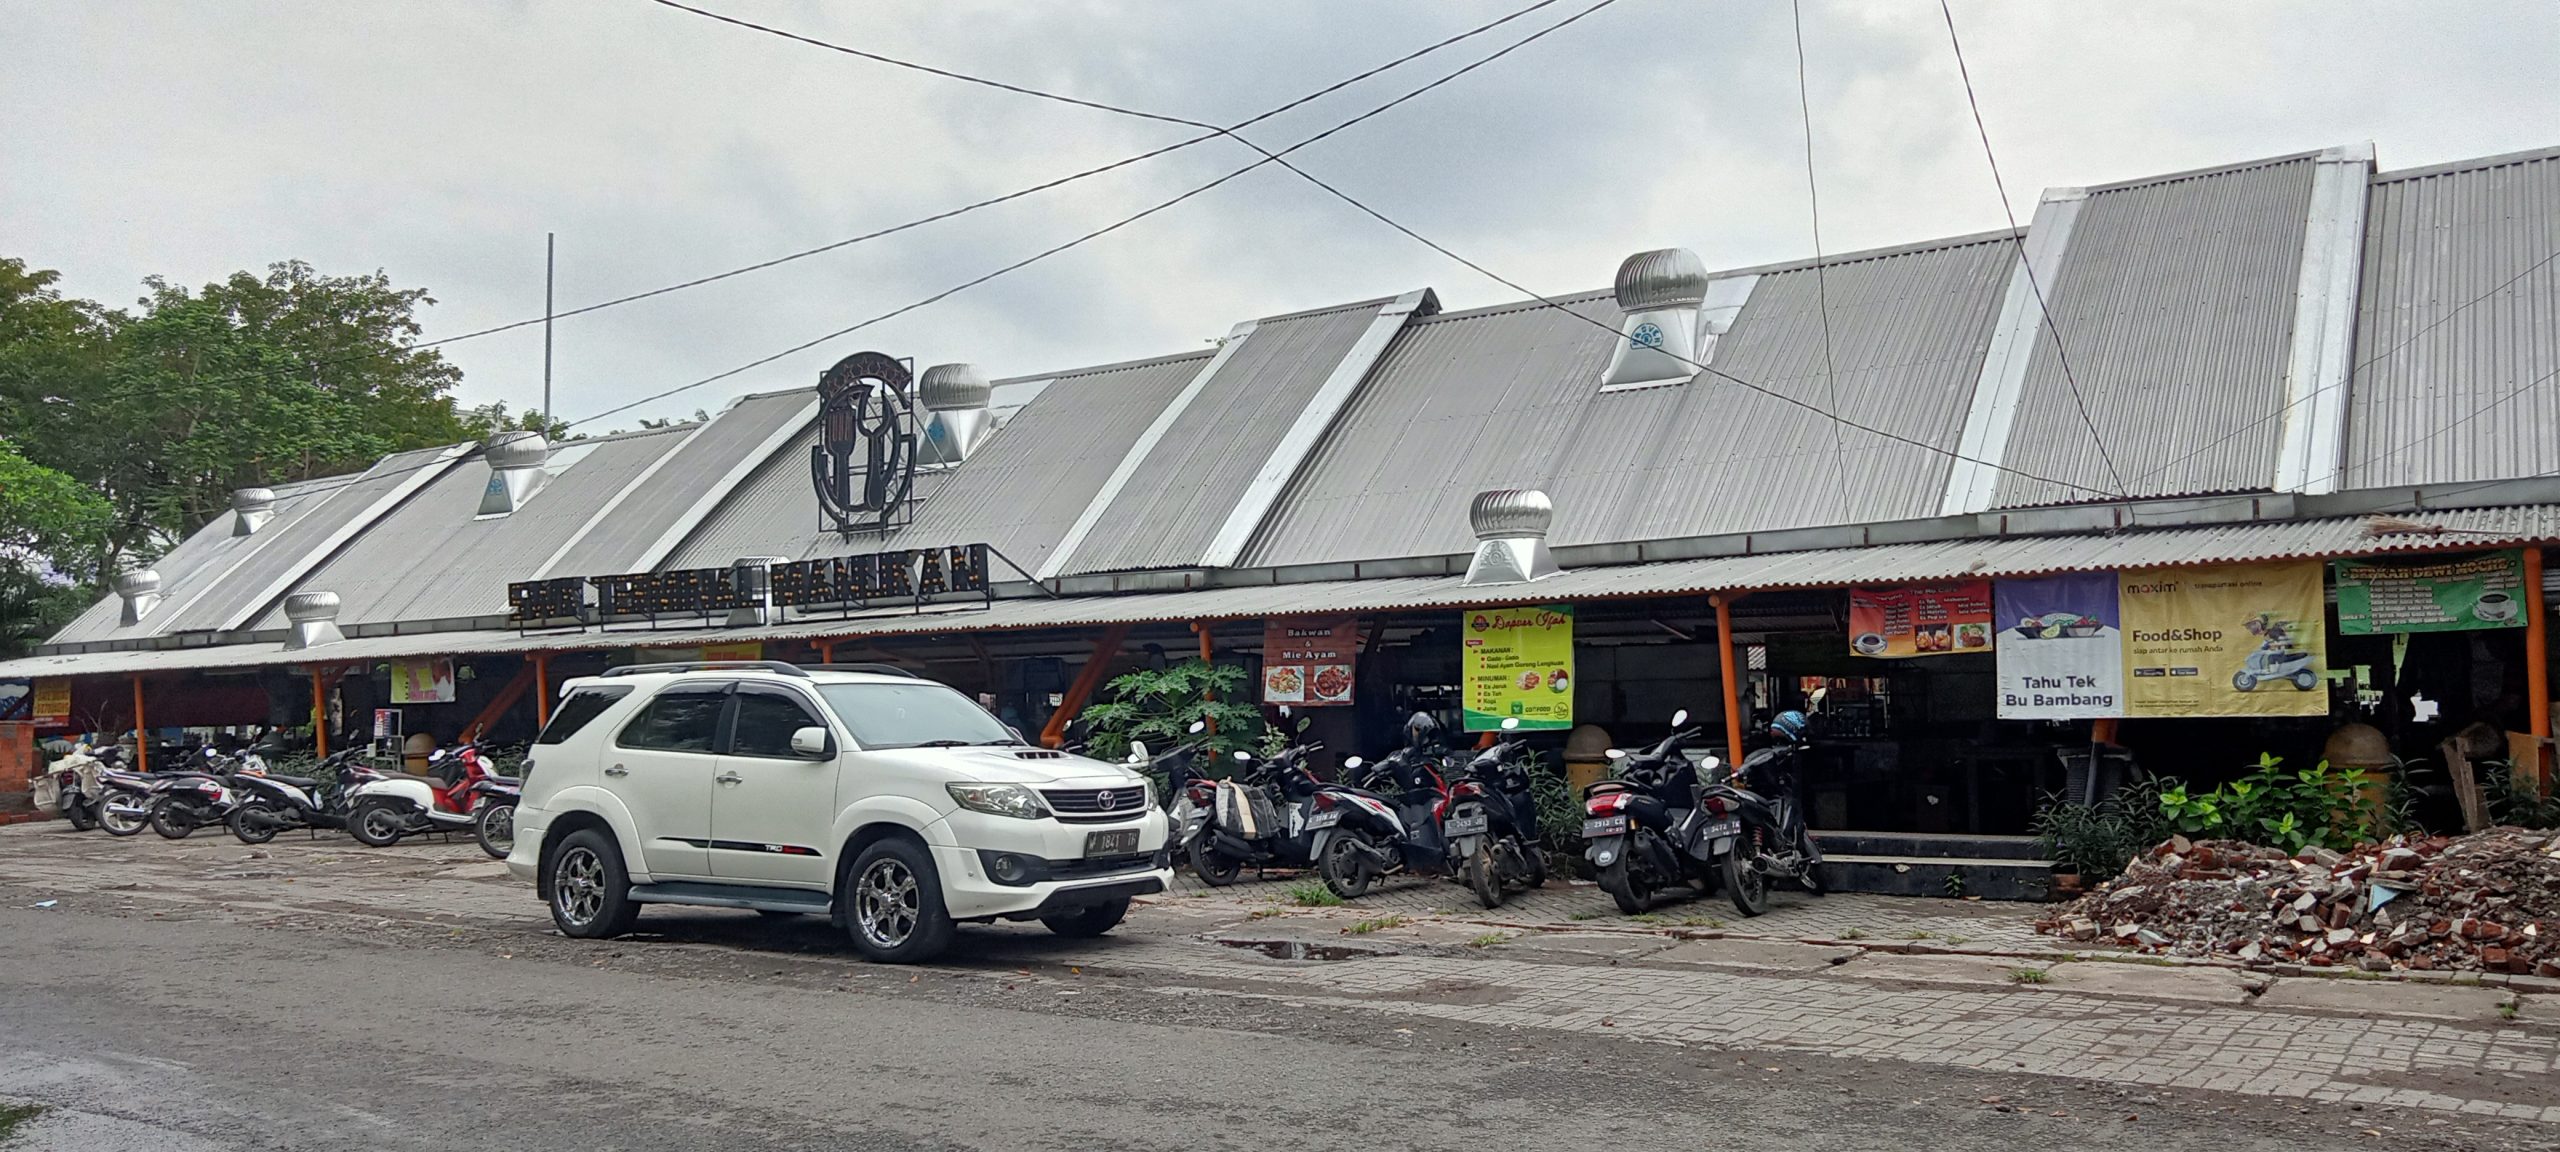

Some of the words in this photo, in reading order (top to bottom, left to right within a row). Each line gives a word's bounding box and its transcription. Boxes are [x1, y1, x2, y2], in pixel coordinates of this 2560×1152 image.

[771, 543, 988, 606] MANUKAN
[2127, 581, 2177, 594] maxim
[1287, 629, 1331, 637] Bakwan
[2132, 629, 2222, 642] Food&Shop
[1282, 651, 1301, 659] Mie
[1305, 651, 1336, 660] Ayam
[2022, 676, 2061, 688] Tahu
[2066, 675, 2096, 688] Tek
[2006, 694, 2027, 706] Bu
[2034, 693, 2113, 708] Bambang
